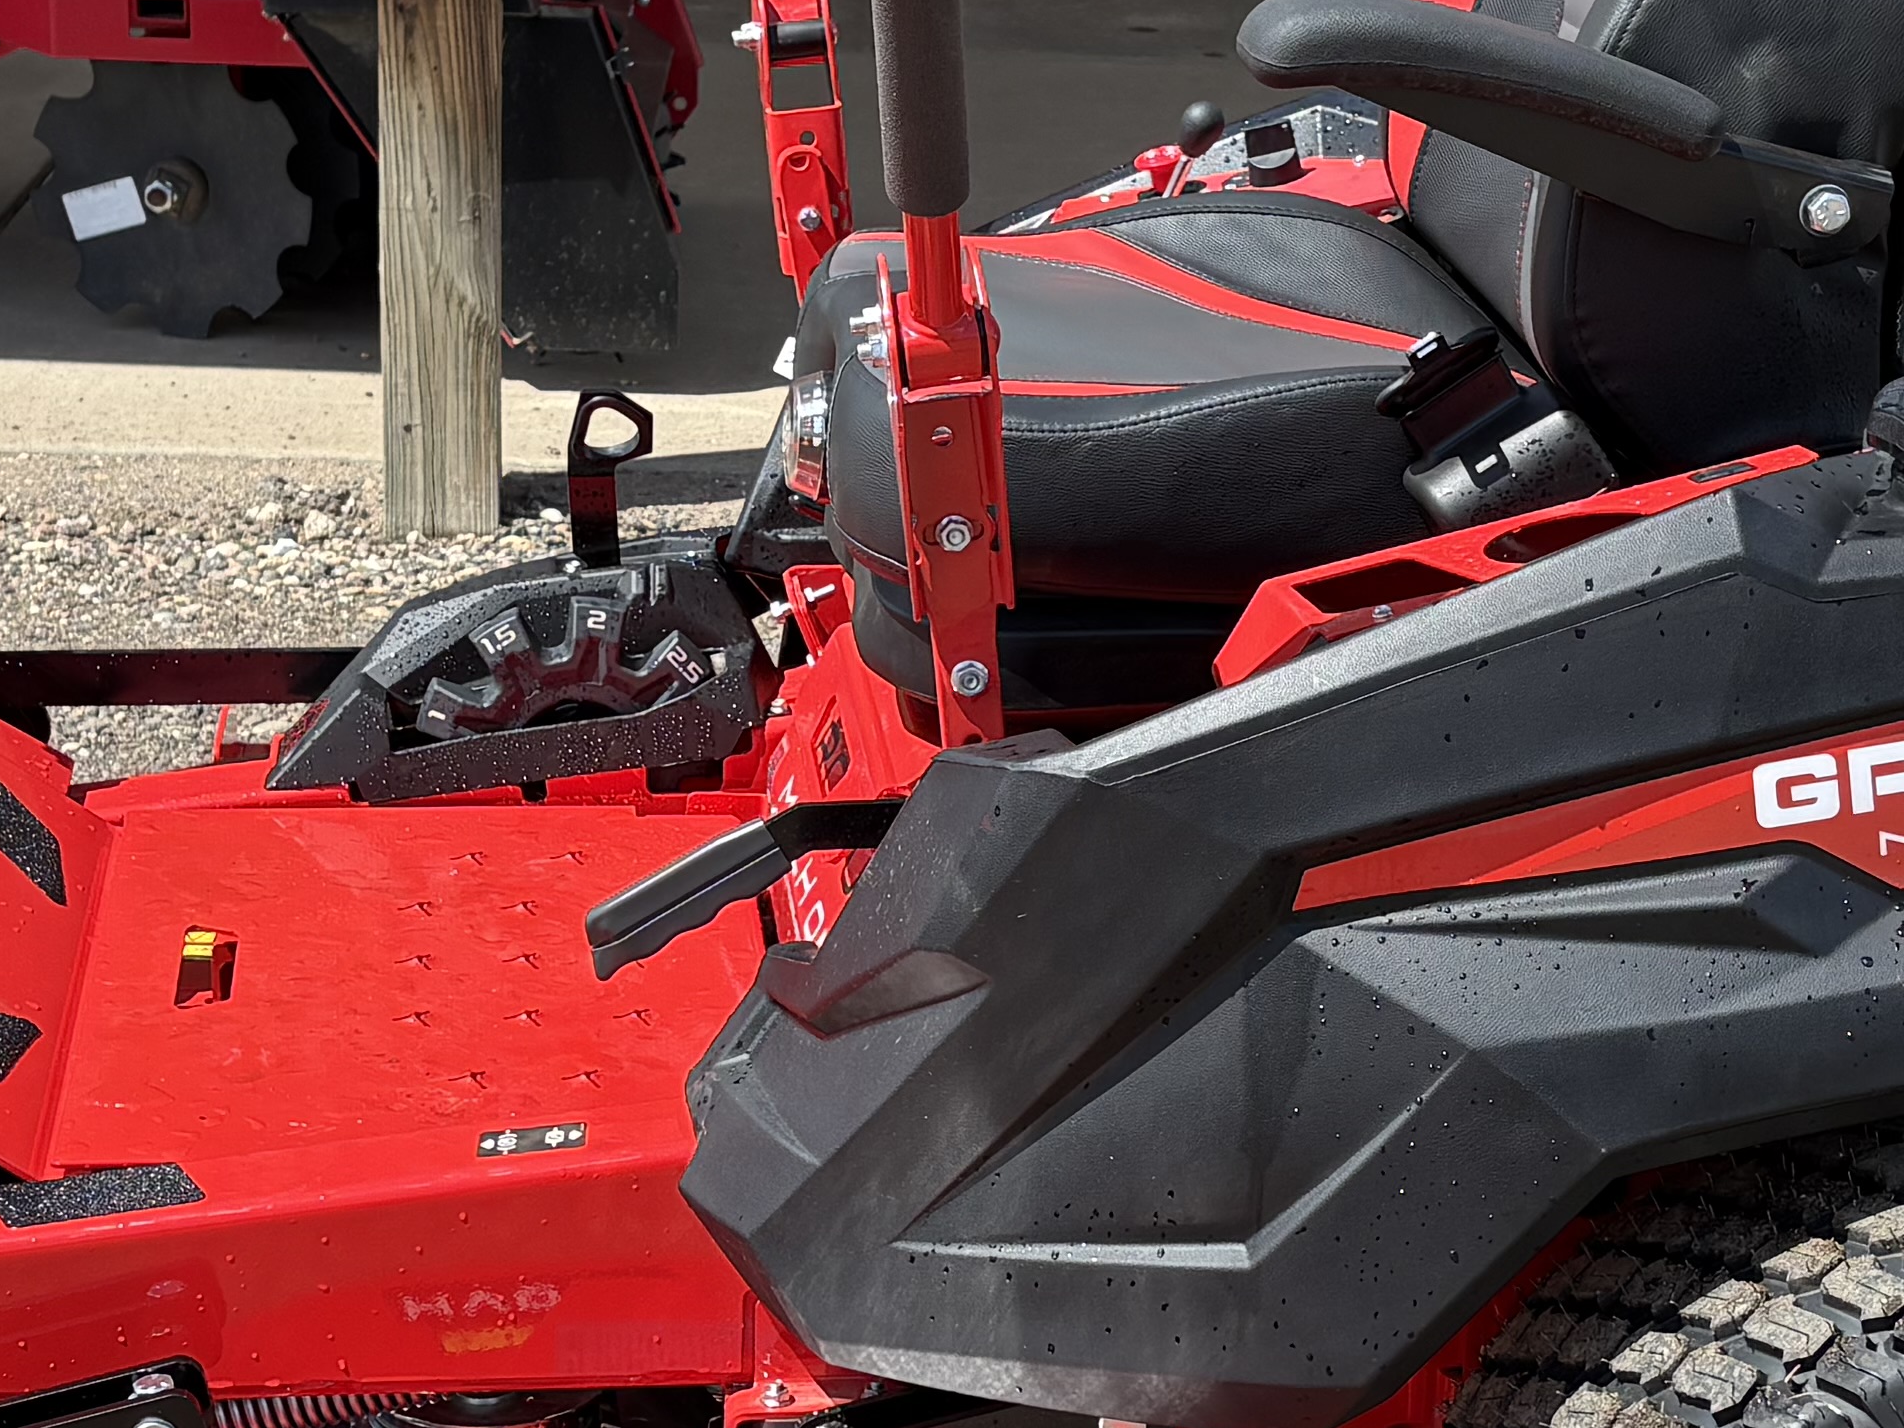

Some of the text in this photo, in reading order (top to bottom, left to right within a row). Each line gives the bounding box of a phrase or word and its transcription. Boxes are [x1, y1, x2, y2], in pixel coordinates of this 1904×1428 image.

[586, 609, 607, 631] 2
[479, 622, 517, 655] 1.5
[665, 644, 704, 685] 2.5
